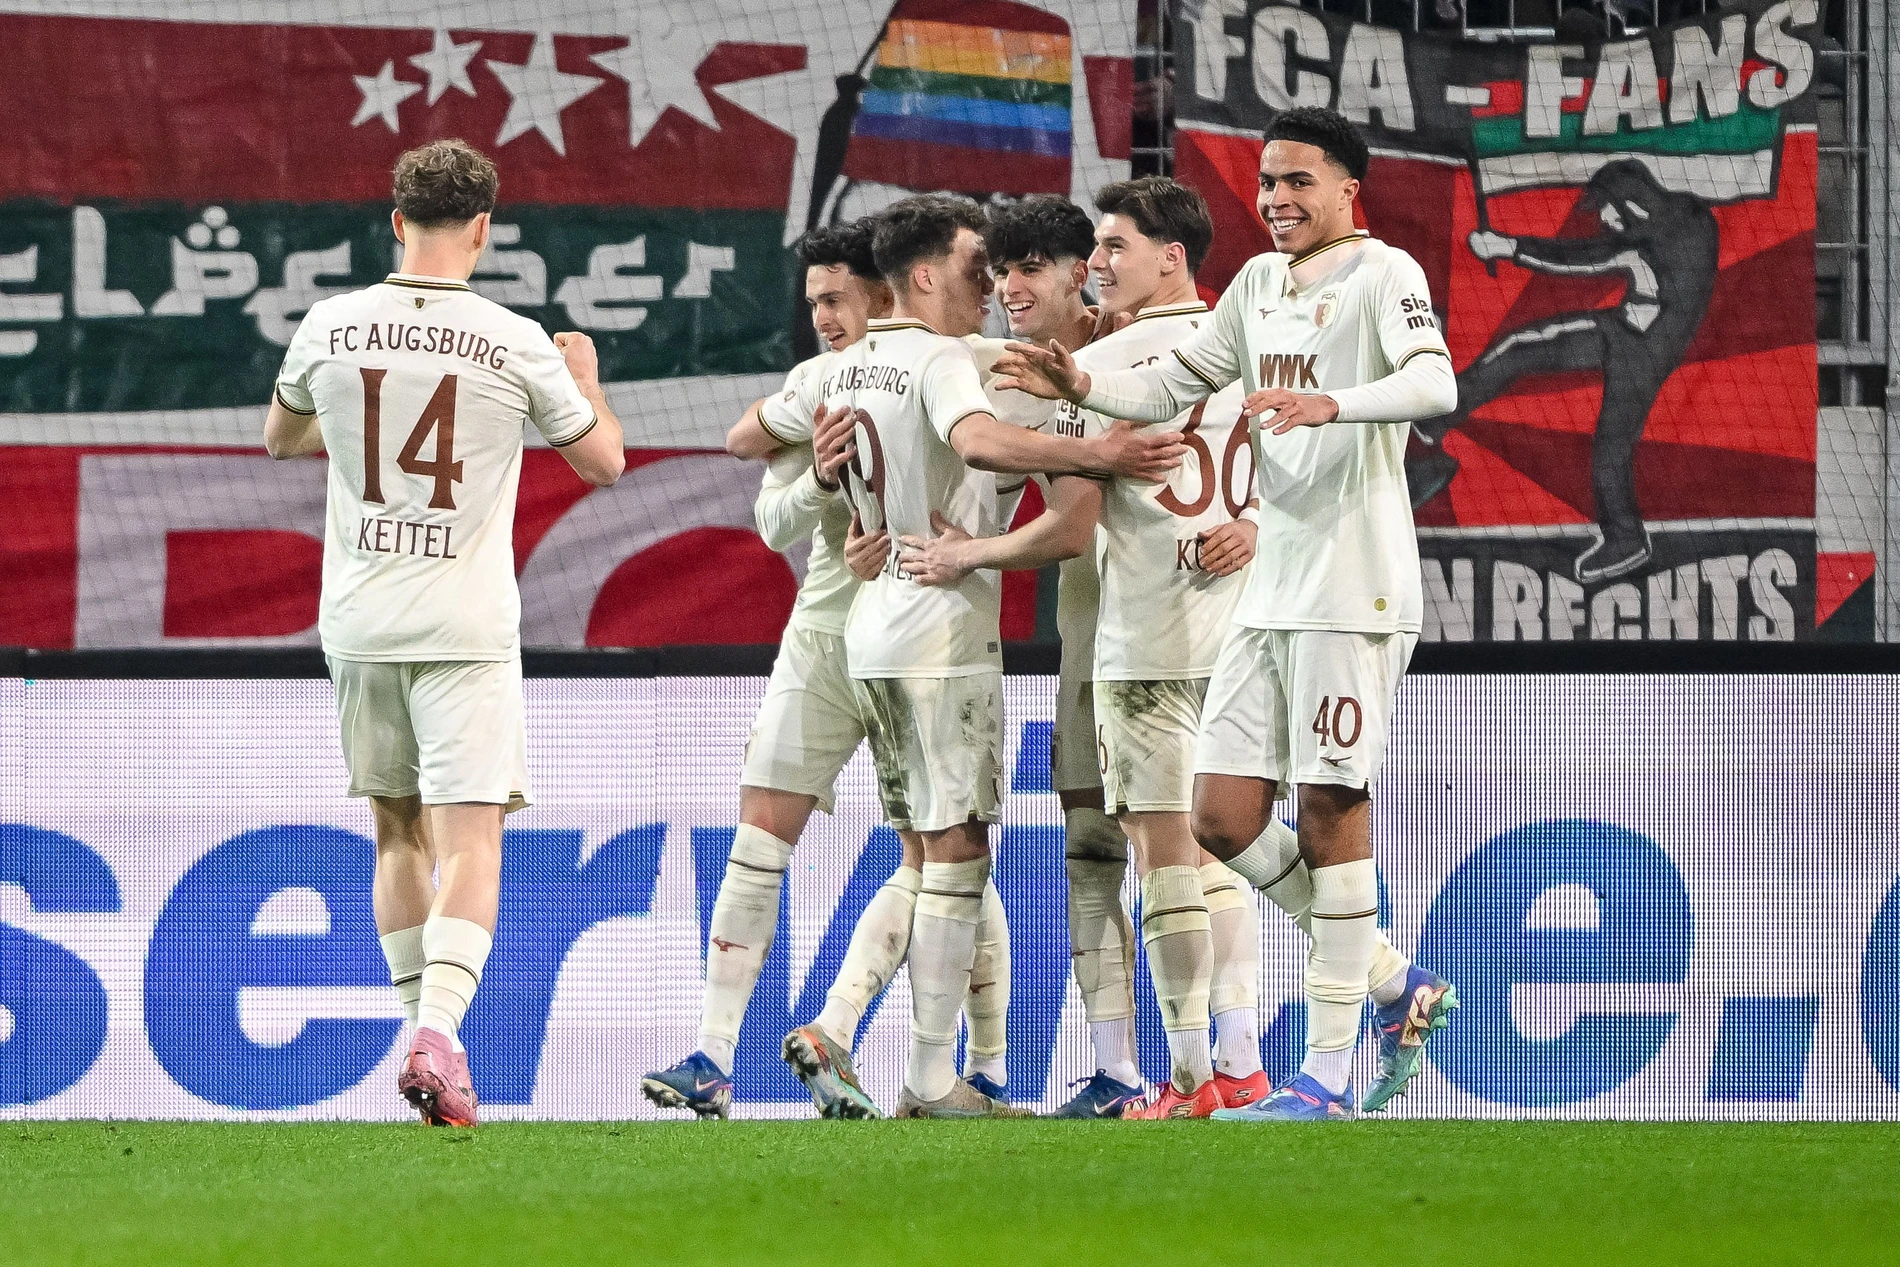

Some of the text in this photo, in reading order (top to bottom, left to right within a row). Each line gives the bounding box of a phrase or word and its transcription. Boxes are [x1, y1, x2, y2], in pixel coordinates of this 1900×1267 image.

[1178, 0, 1416, 131] FCA
[1525, 1, 1820, 138] FANS
[329, 323, 509, 370] FC AUGSBURG
[1259, 353, 1319, 389] WWK
[359, 367, 464, 511] 14
[357, 517, 457, 559] KEITEL
[1493, 548, 1797, 642] RECHTS
[1312, 695, 1363, 748] 40
